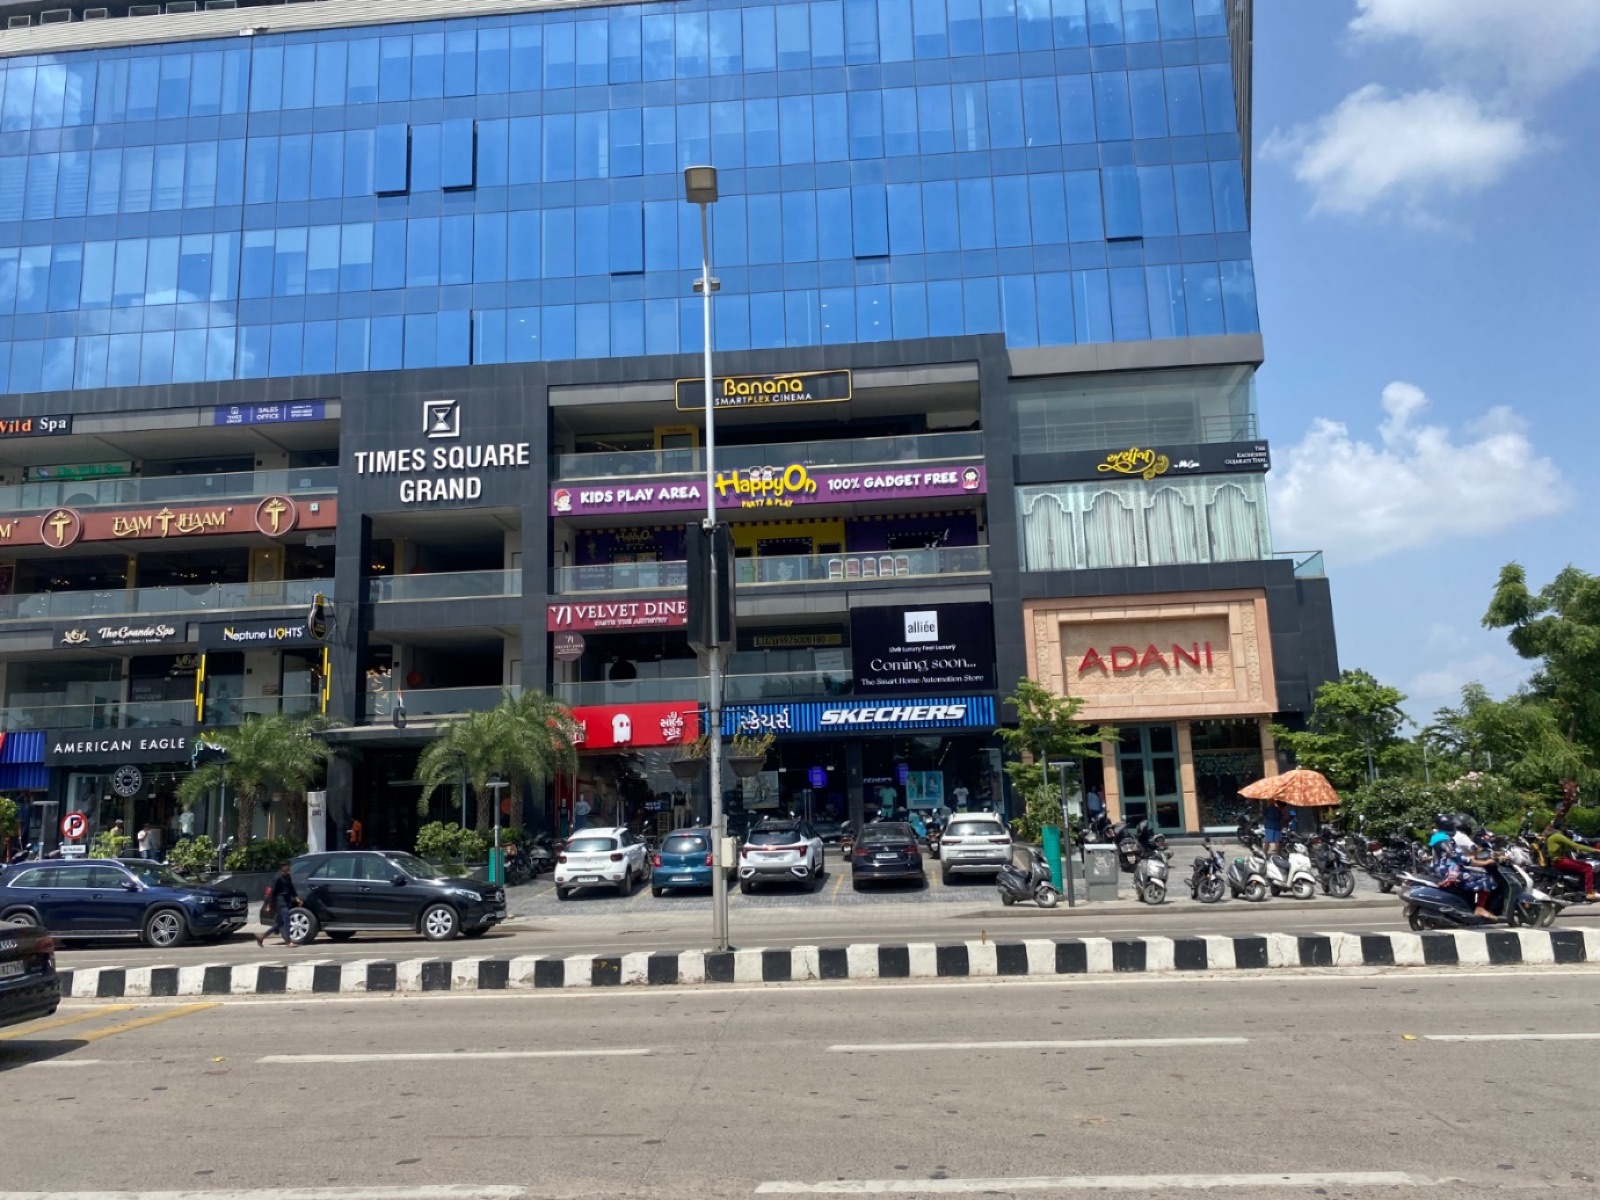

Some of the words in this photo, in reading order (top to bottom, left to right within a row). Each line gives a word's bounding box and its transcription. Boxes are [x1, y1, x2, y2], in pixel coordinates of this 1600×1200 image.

[723, 379, 802, 395] Banana
[715, 394, 770, 405] SMARTPLEX
[772, 392, 812, 402] CINEMA
[258, 406, 278, 414] SALES
[39, 416, 67, 432] Spa
[354, 448, 427, 474] TIMES
[432, 443, 531, 469] SQUARE
[715, 464, 817, 497] HappyOn
[827, 477, 861, 491] 100%
[863, 474, 921, 489] GADGET
[924, 471, 959, 484] FREE
[399, 477, 482, 502] GRAND
[579, 490, 613, 504] KIDS
[616, 488, 654, 502] PLAY
[658, 486, 700, 500] AREA
[741, 500, 765, 508] PARTY
[766, 499, 773, 507] &
[775, 499, 794, 508] PLAY
[575, 603, 639, 620] VELVET
[644, 601, 687, 616] DINE
[98, 627, 117, 639] The
[155, 624, 175, 638] Spa
[223, 627, 267, 642] Neptune
[268, 626, 303, 640] LIGHTS
[907, 620, 936, 634] alliée
[870, 658, 929, 672] Coming
[931, 658, 977, 669] soon...
[1078, 641, 1212, 673] ADANI
[861, 678, 876, 686] The
[821, 704, 967, 725] SKECHERS
[53, 740, 132, 754] AMERICAN
[140, 738, 185, 750] EAGLE
